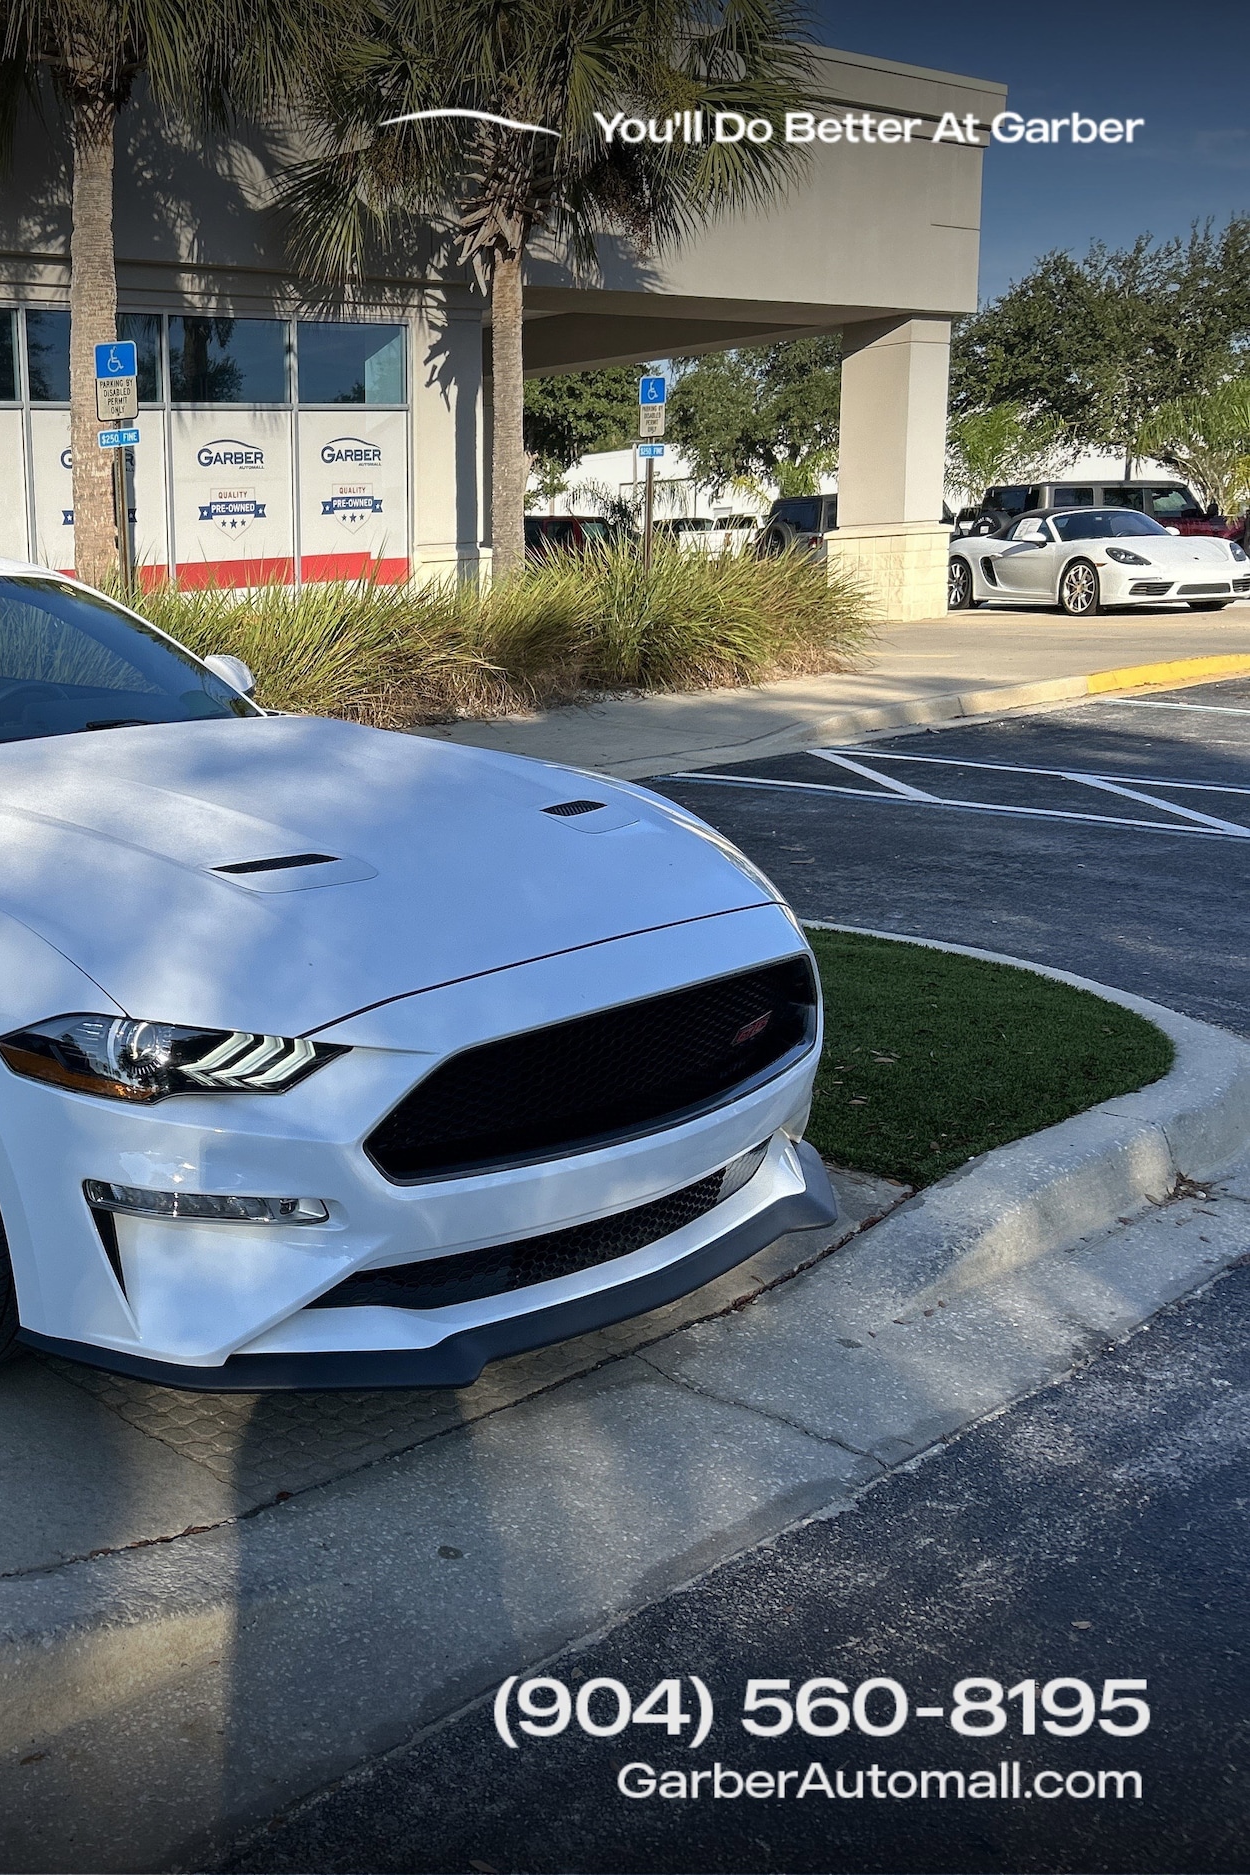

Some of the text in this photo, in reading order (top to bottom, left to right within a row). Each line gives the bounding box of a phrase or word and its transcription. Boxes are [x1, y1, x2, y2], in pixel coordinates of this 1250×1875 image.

[99, 379, 133, 389] PARKING BY
[103, 388, 131, 397] DISABLED
[107, 397, 128, 406] PERMIT
[110, 406, 125, 414] ONLY
[101, 431, 138, 445] $250 FINE
[197, 448, 265, 467] GARBER
[321, 446, 381, 464] GARBER
[218, 491, 247, 499] QUALITY
[339, 486, 366, 494] QUALITY
[211, 503, 255, 513] PRE-OWNED
[332, 498, 372, 508] PRE-OWNED
